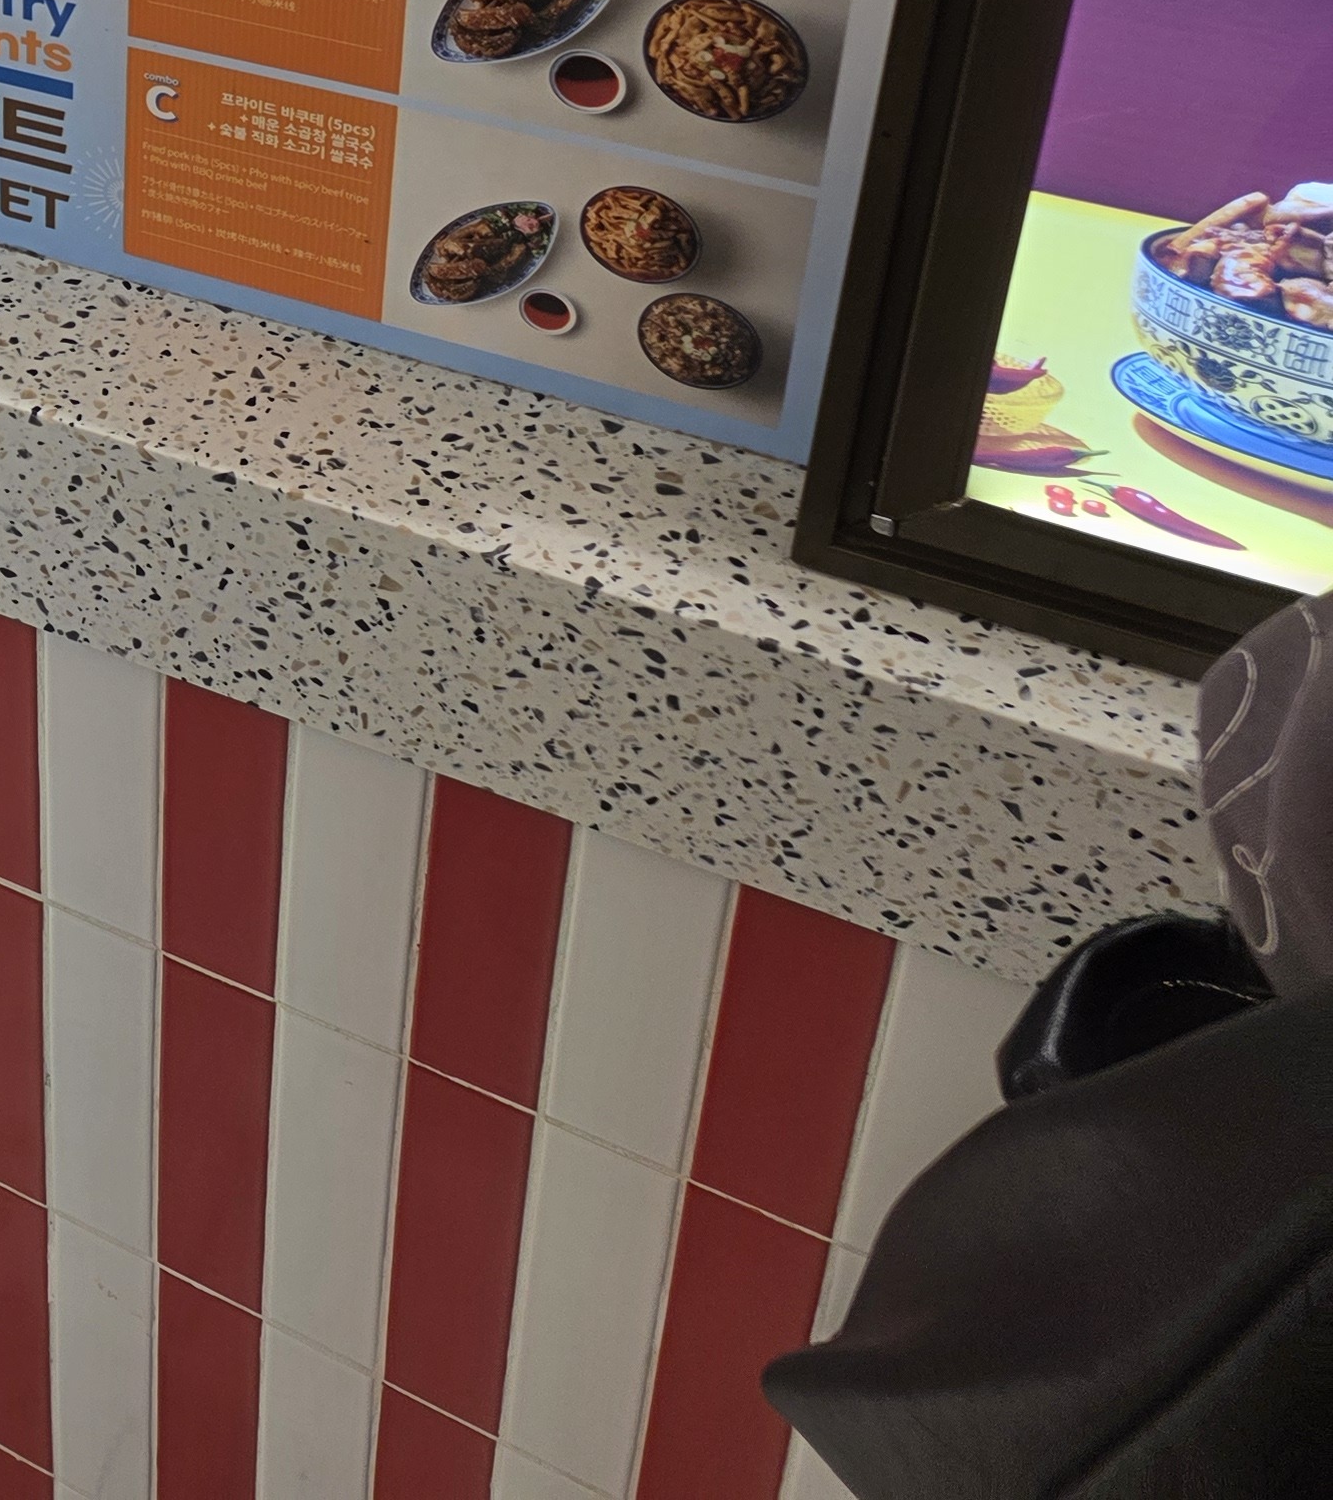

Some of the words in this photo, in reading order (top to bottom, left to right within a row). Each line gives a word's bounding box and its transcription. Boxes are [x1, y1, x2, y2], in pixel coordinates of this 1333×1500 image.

[143, 71, 180, 86] combo
[145, 85, 179, 122] C
[220, 91, 278, 116] 프라이드
[280, 104, 324, 127] 바쿠테
[327, 115, 376, 141] (5pcs)
[251, 114, 280, 133] 매운
[283, 123, 327, 144] 소곱창
[330, 132, 375, 155] 쌀국수
[251, 129, 279, 149] 직화
[282, 137, 326, 160] 소고기
[329, 147, 374, 170] 쌀국수
